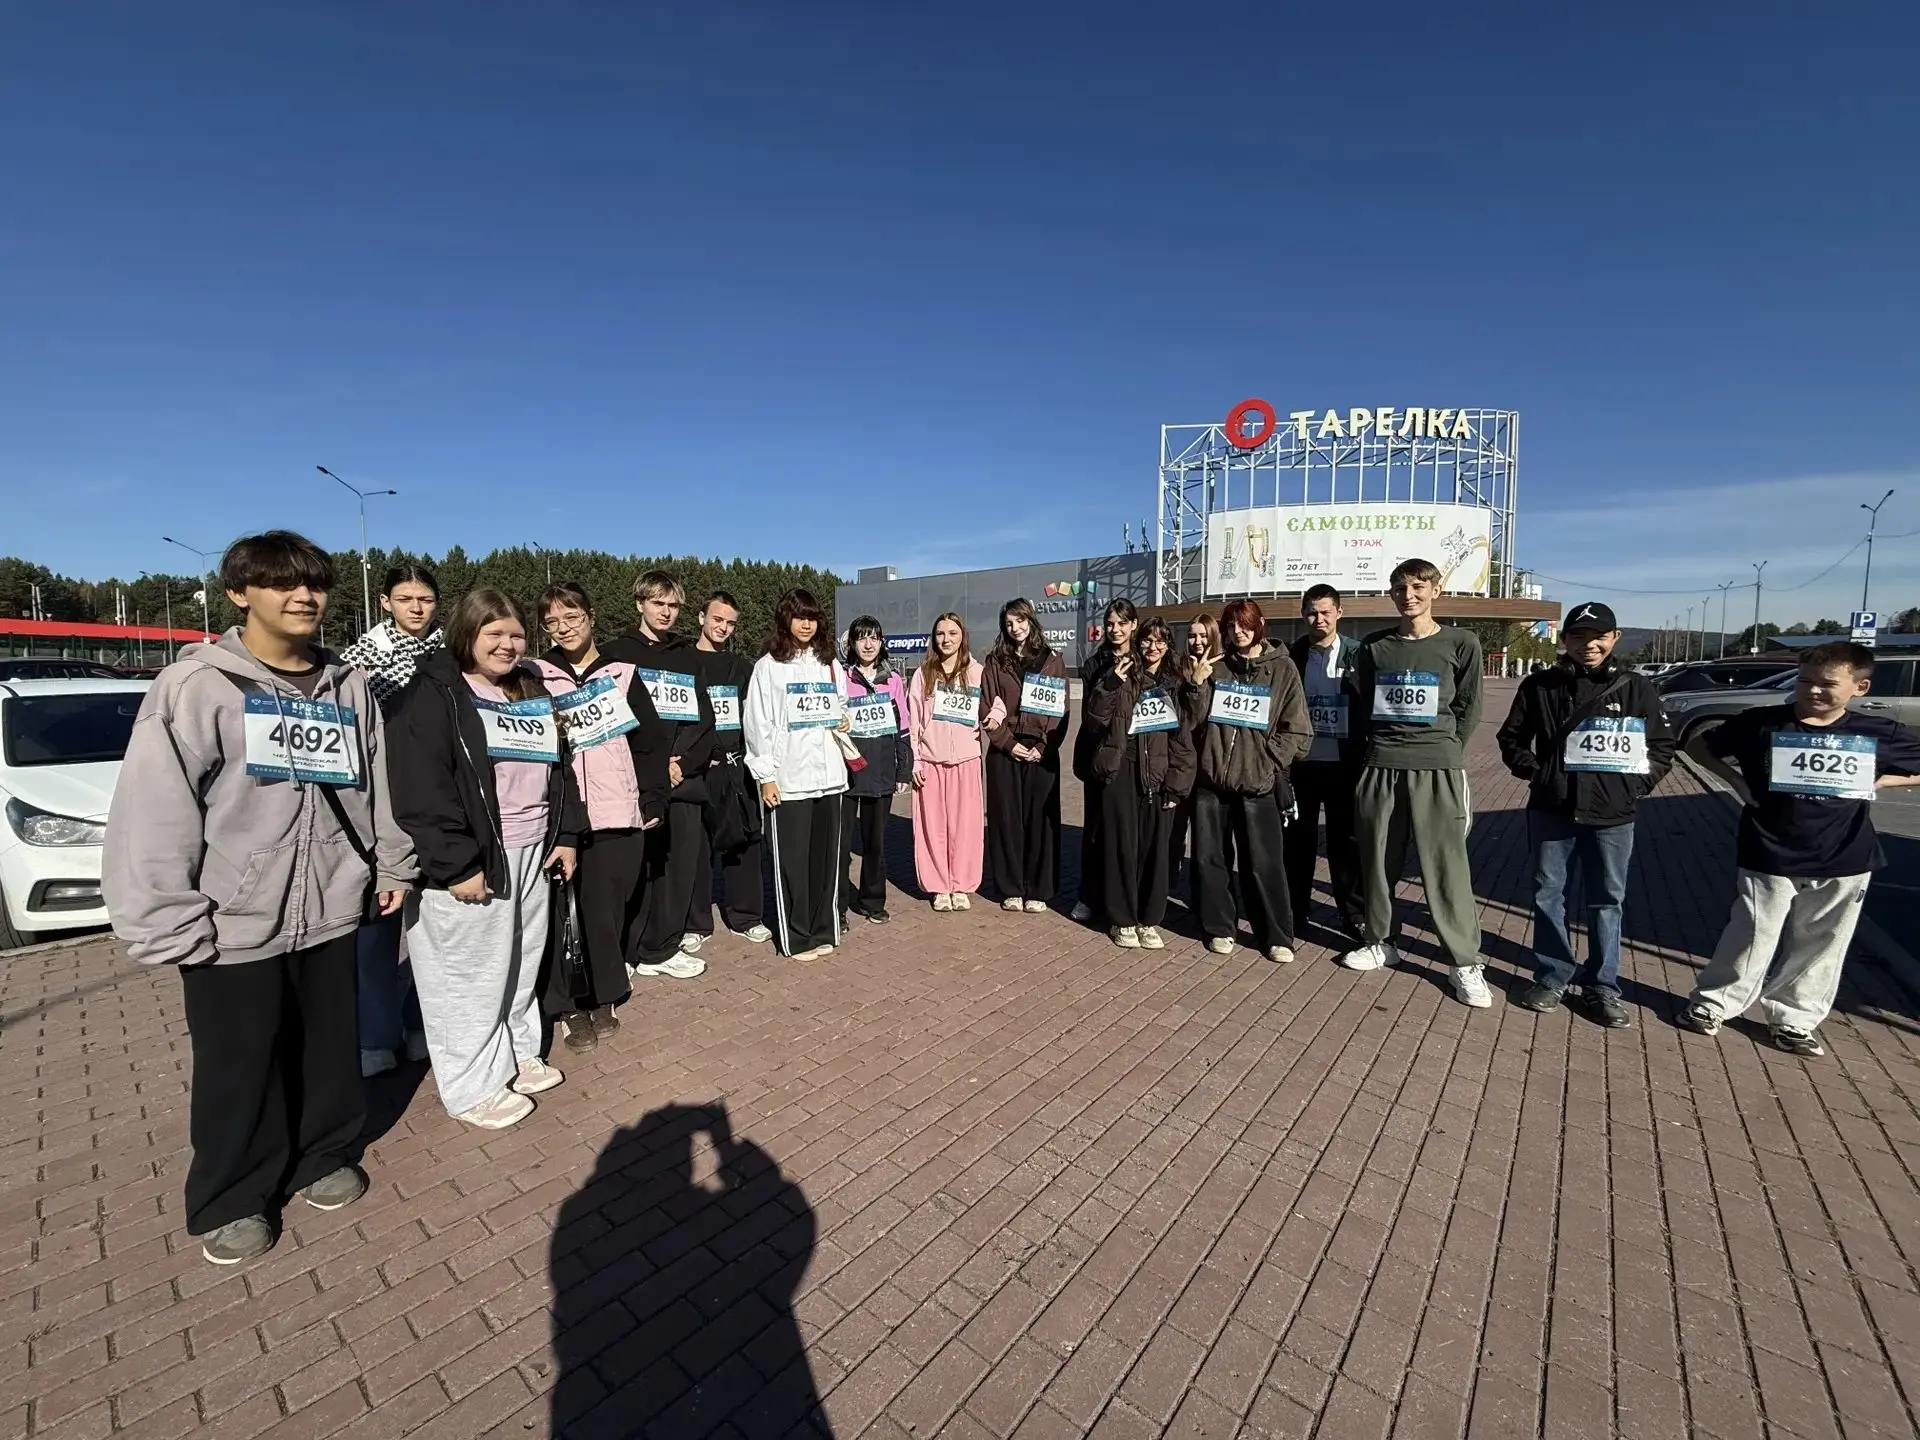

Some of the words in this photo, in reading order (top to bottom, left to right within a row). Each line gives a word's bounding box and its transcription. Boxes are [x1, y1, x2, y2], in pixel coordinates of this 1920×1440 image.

[1290, 407, 1472, 440] ТАРЕЛКА
[1286, 514, 1436, 533] САМОЦВЕТЫ
[1351, 539, 1383, 548] ЭТАЖ
[1299, 563, 1320, 571] ЛЕТ
[1357, 562, 1369, 570] 40
[1860, 613, 1874, 627] P
[1042, 629, 1076, 641] ЯРИС
[1030, 687, 1057, 703] 4866
[1385, 688, 1426, 706] 4986
[713, 700, 730, 715] 55
[796, 696, 831, 711] 4278
[1222, 695, 1260, 713] 4812
[855, 706, 886, 723] 4369
[1310, 708, 1339, 724] 943
[496, 715, 545, 737] 4709
[269, 722, 341, 754] 4692
[1791, 752, 1859, 775] 4626
